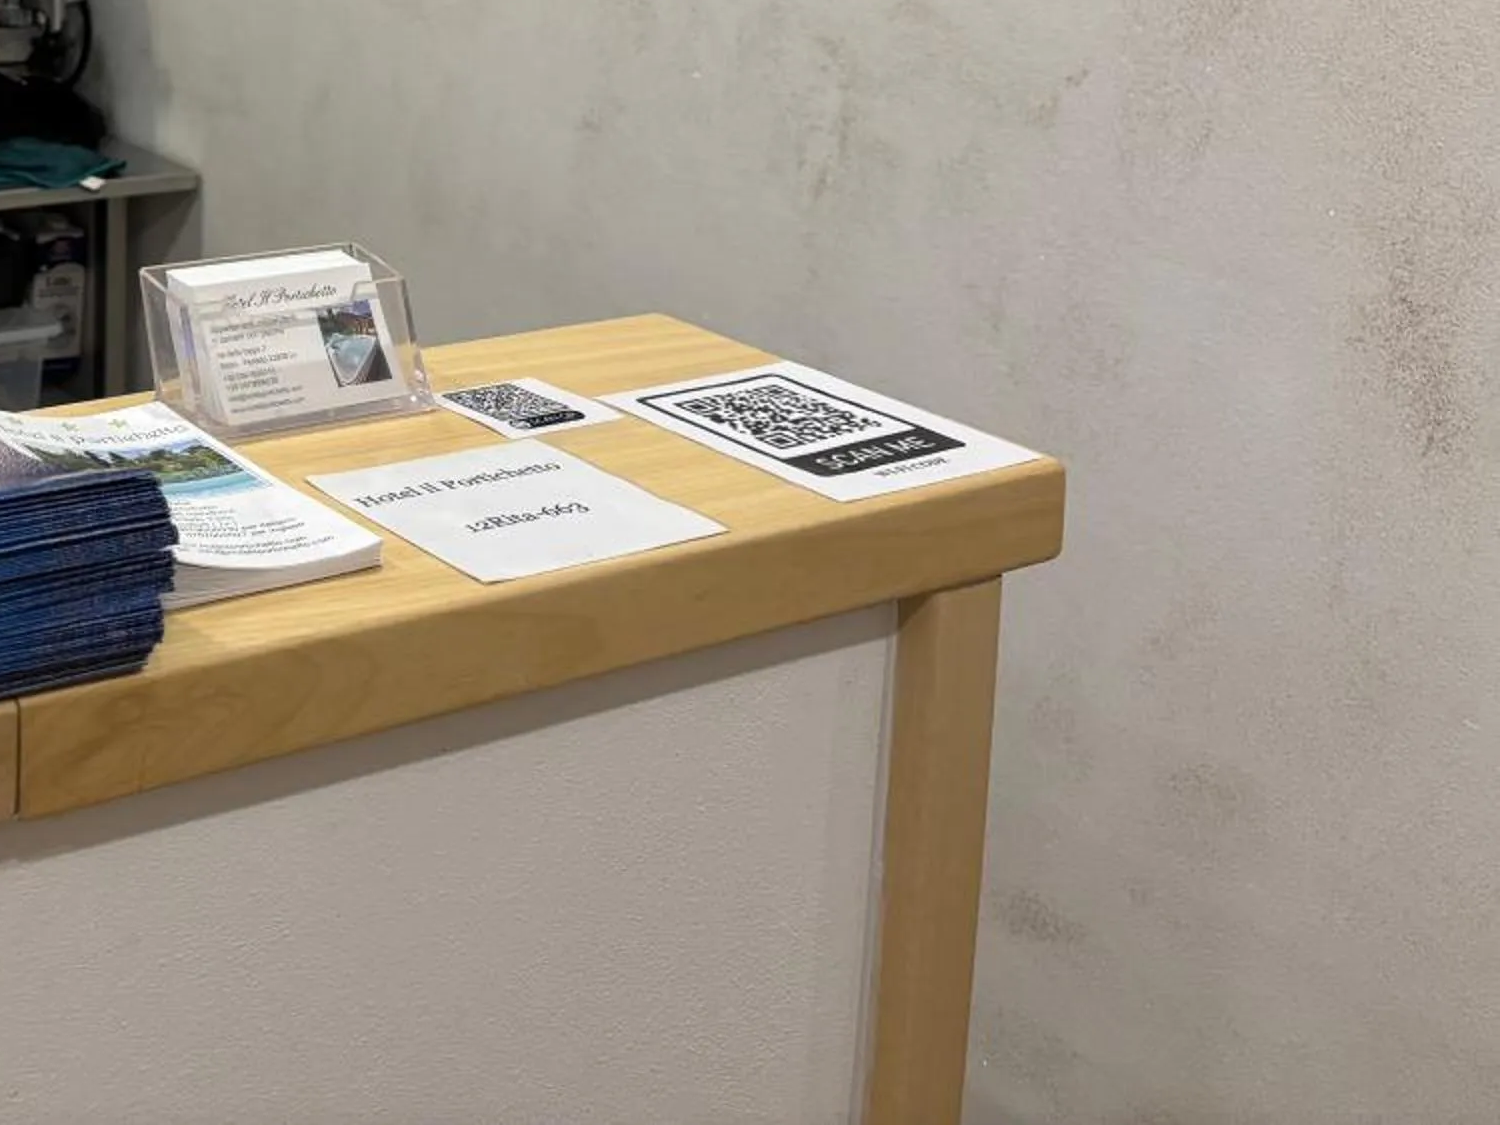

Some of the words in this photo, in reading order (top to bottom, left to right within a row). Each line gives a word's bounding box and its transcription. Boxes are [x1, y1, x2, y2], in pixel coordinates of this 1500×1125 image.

[815, 446, 891, 472] SCAN
[888, 435, 938, 458] ME
[355, 485, 422, 509] Hotel
[440, 461, 563, 491] Portichetto
[465, 501, 591, 534] 12Rita-663
